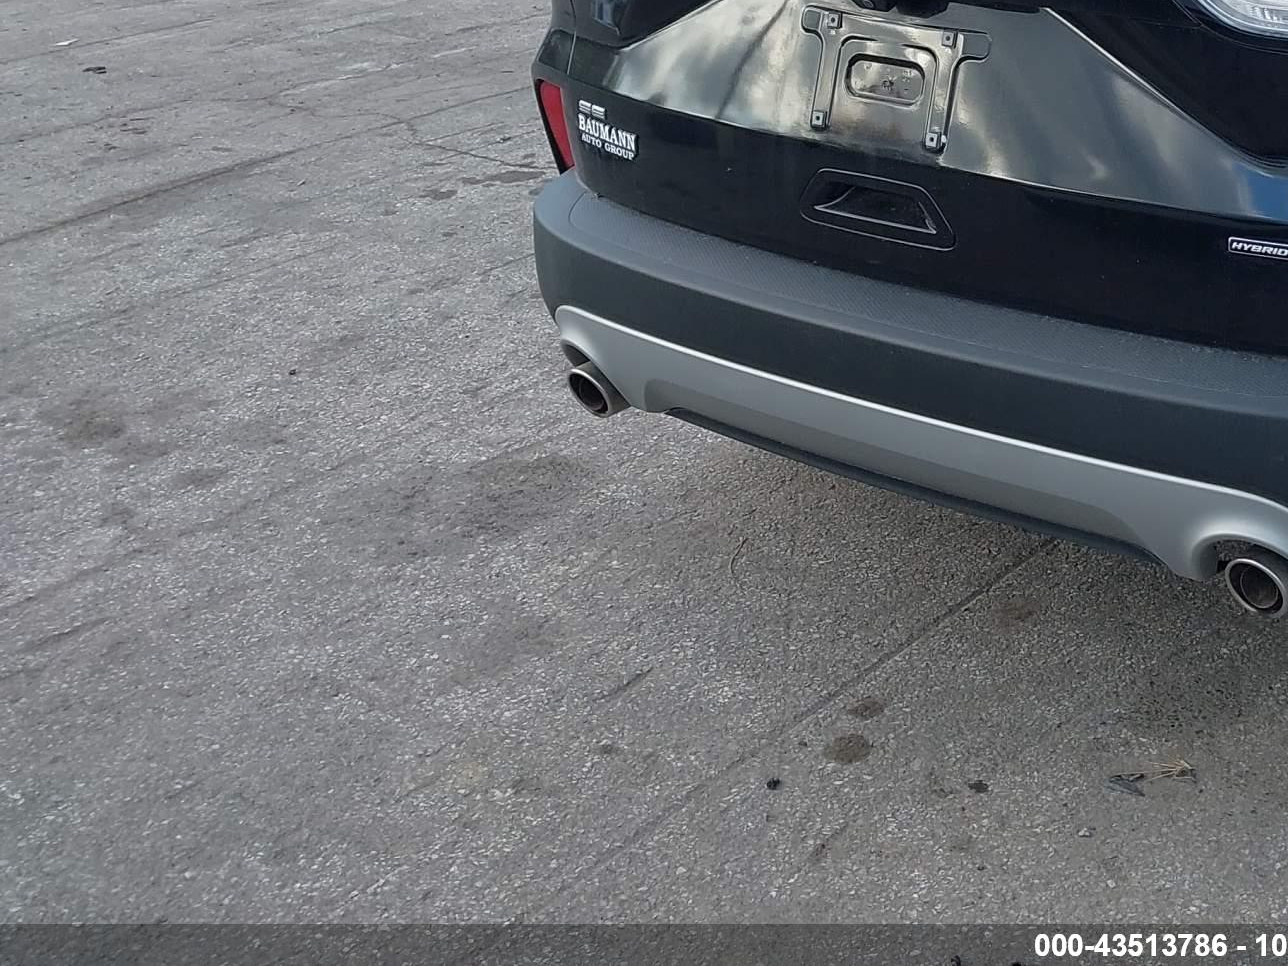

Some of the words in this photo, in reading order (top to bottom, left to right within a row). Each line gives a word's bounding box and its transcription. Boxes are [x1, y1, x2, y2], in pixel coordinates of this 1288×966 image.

[578, 113, 636, 152] BAUMANN
[581, 133, 602, 148] AUTO
[604, 143, 635, 161] GROUP
[1232, 242, 1288, 256] HYBRID
